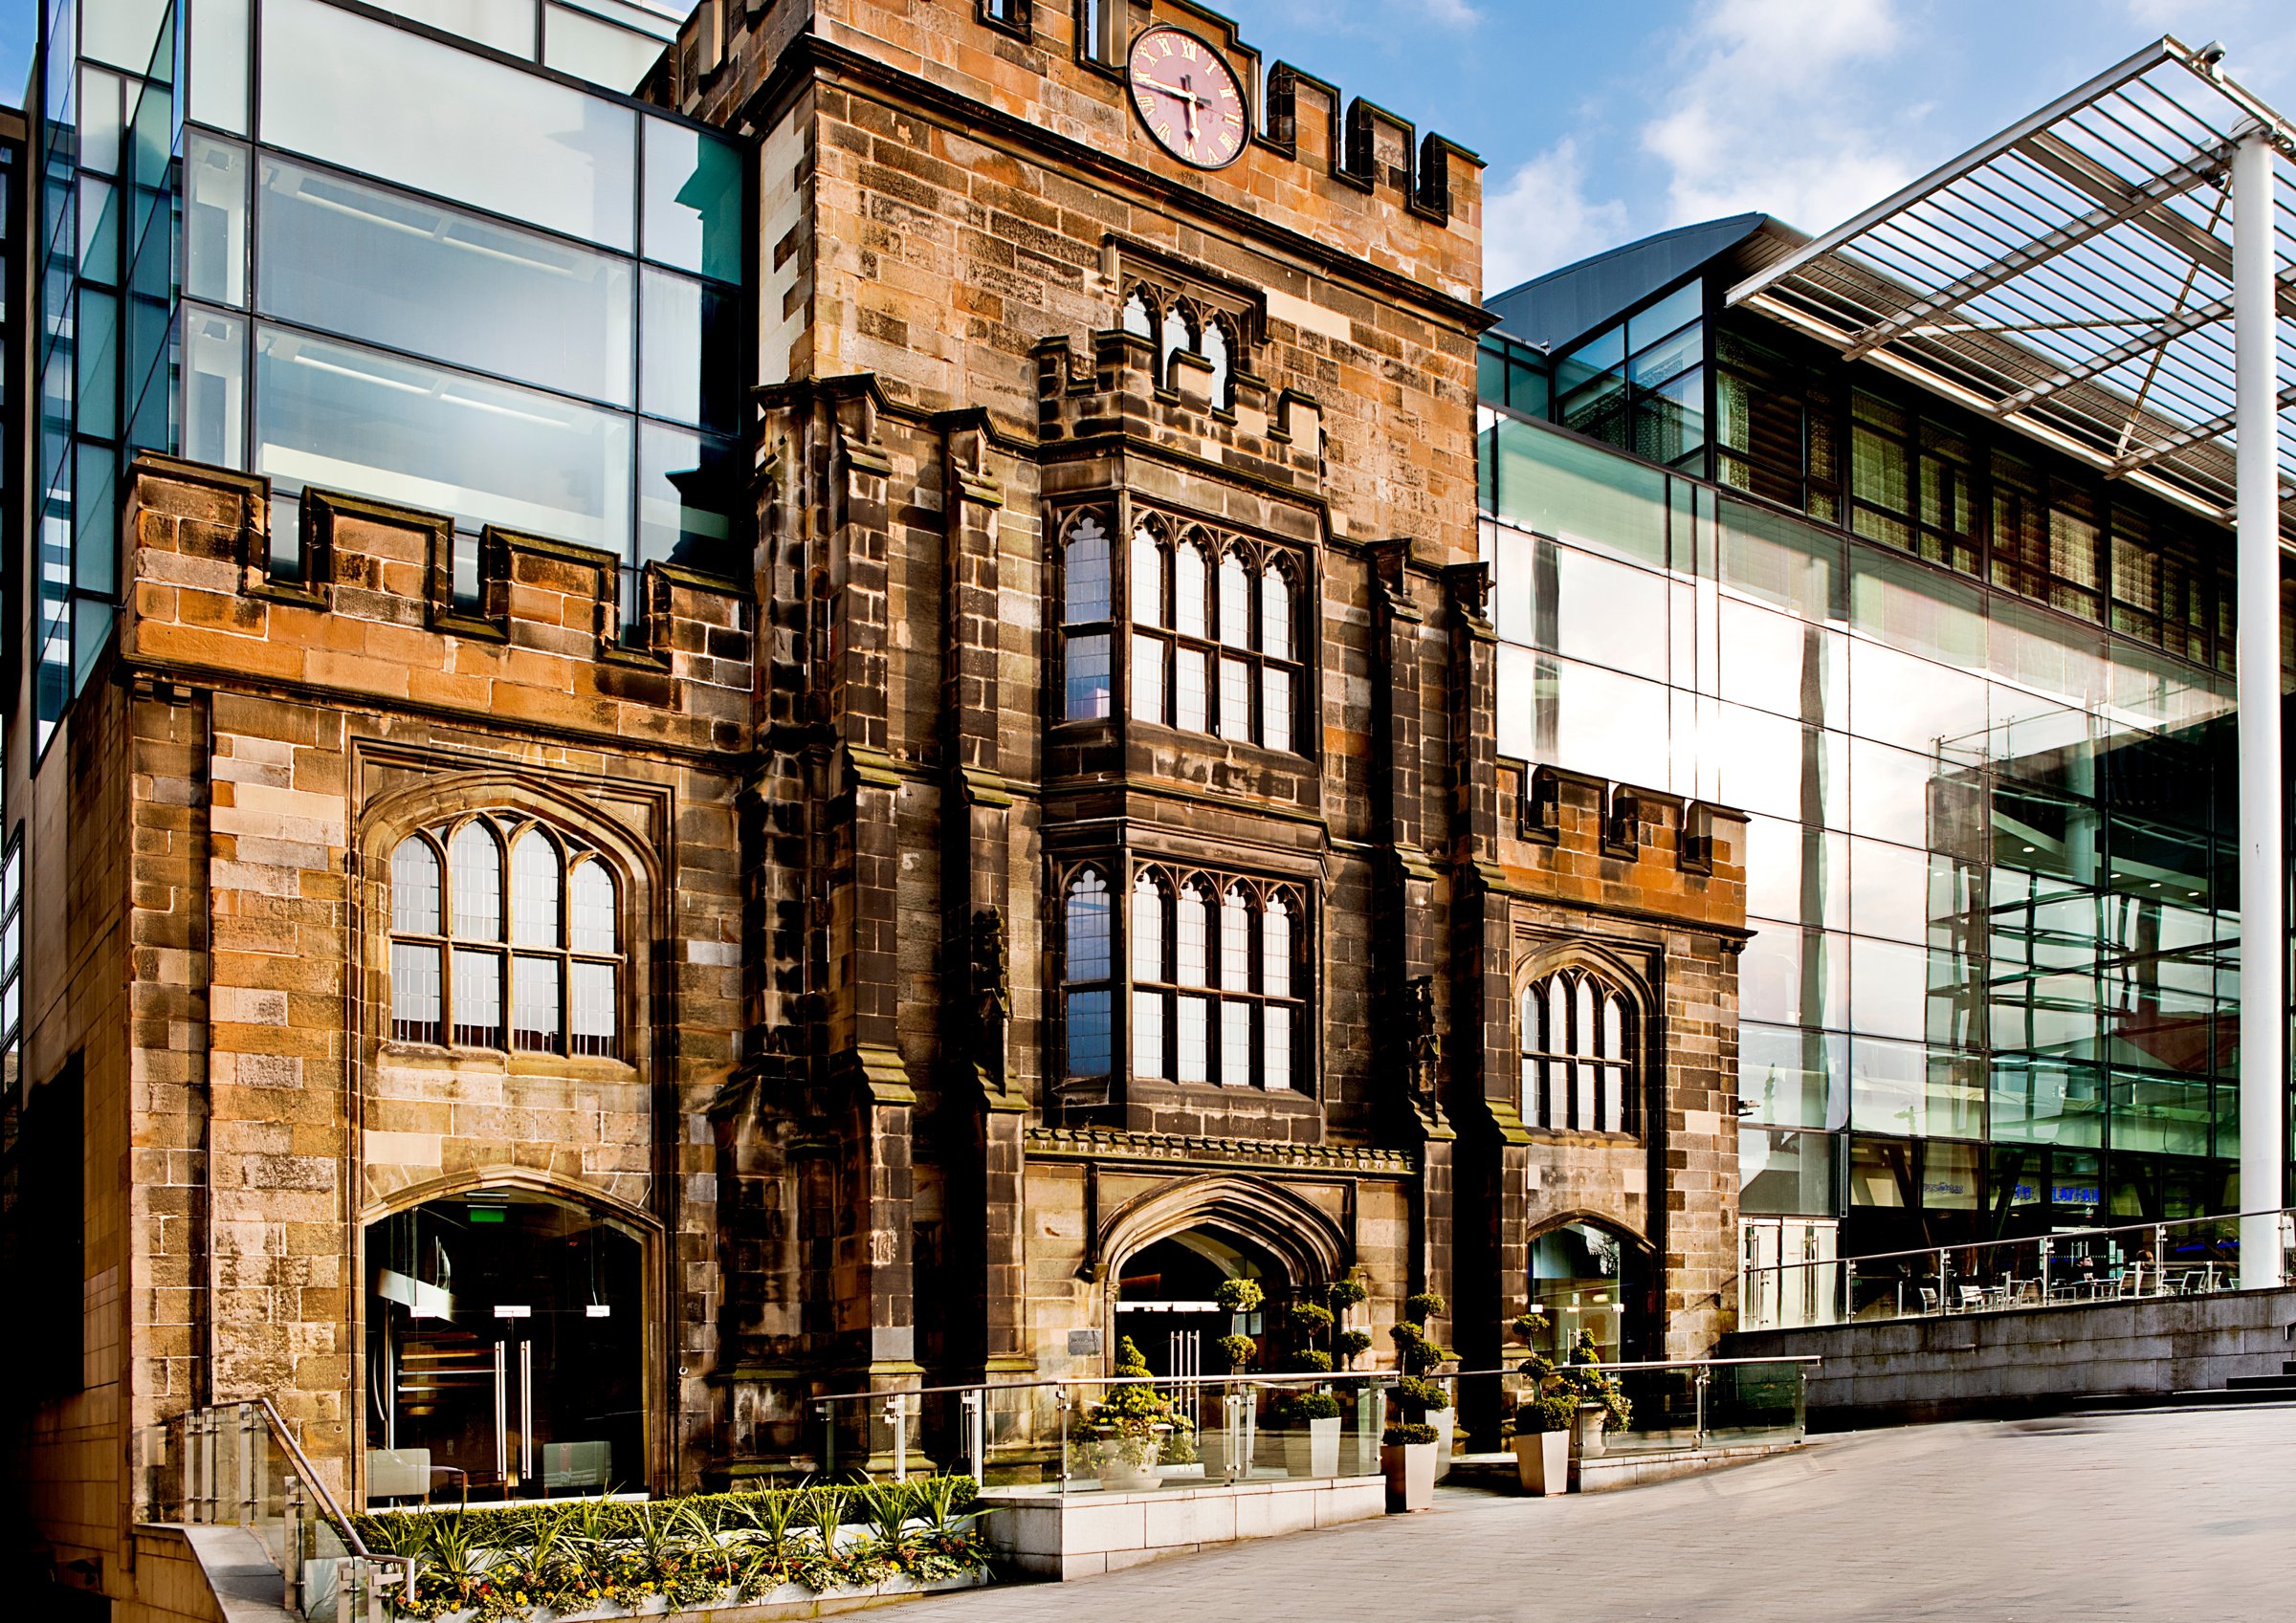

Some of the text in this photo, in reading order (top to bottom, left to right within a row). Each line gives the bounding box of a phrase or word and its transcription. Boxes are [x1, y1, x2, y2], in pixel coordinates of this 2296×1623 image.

[1139, 46, 1158, 67] X
[1181, 39, 1197, 62] XII
[1204, 59, 1218, 77] I
[1218, 87, 1235, 99] II
[1137, 95, 1156, 118] VIII
[1183, 140, 1197, 161] VI
[1206, 144, 1220, 163] V
